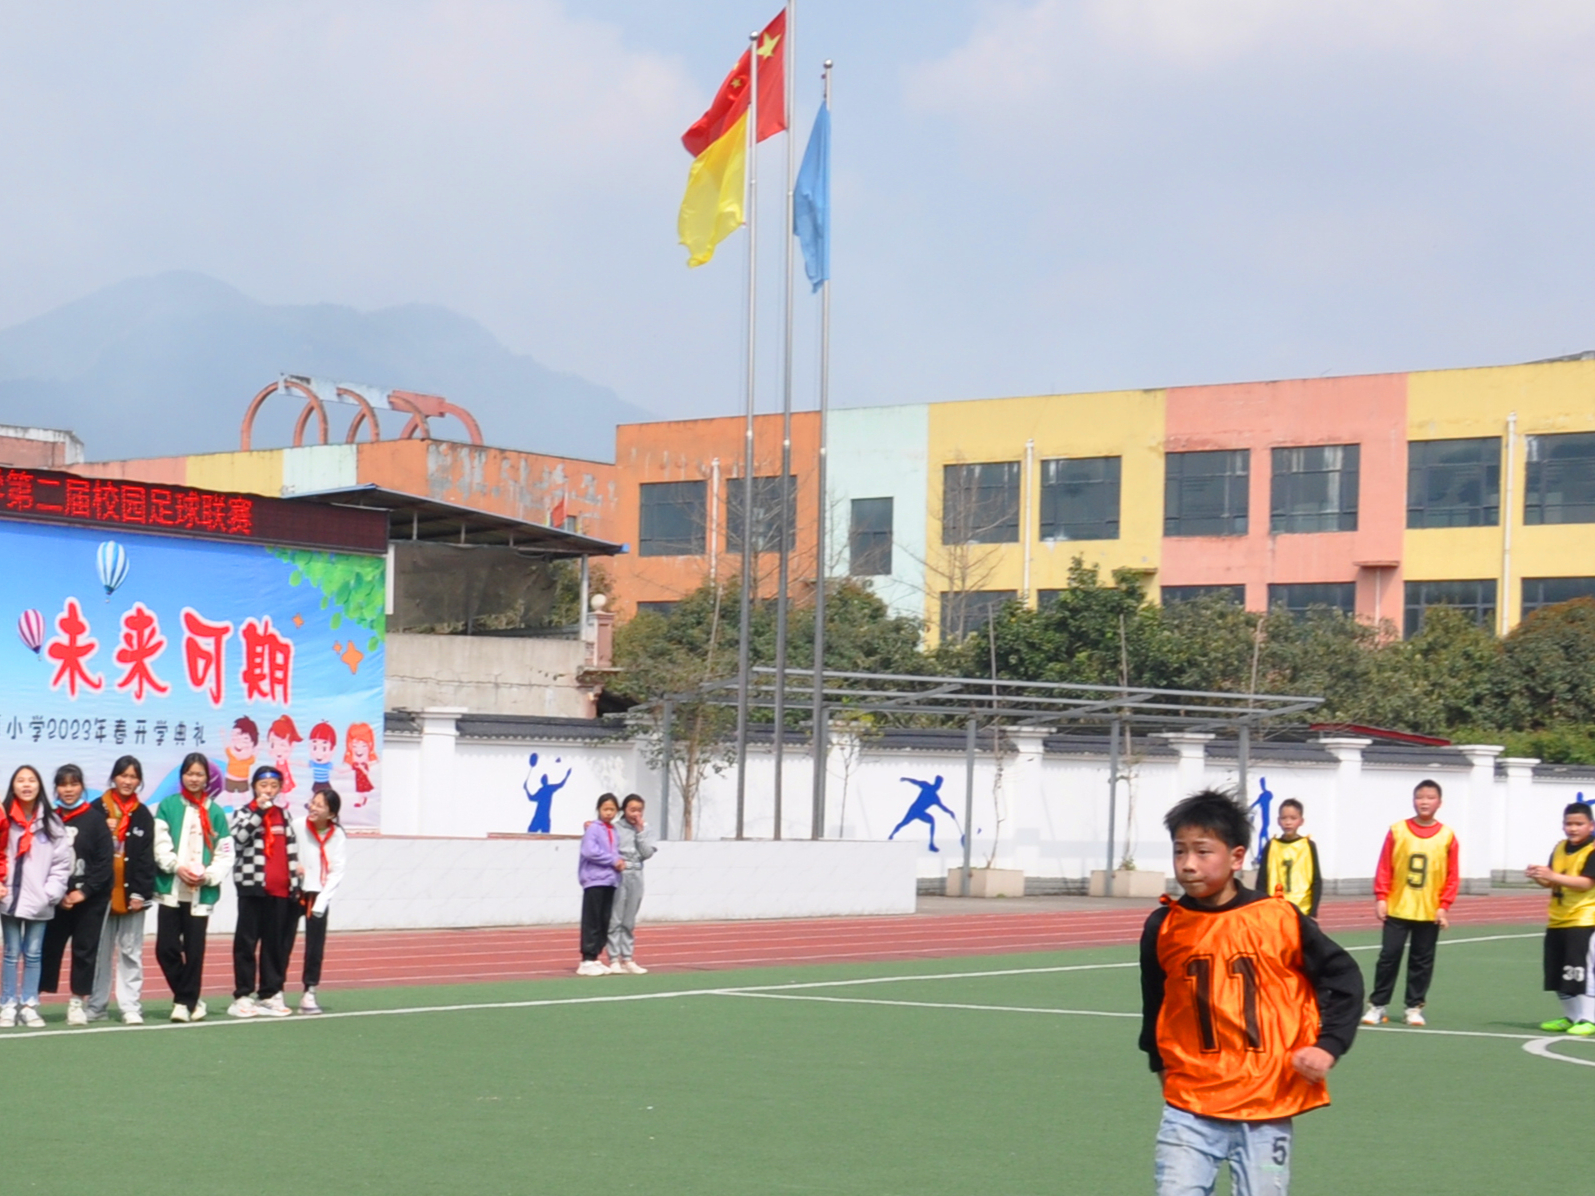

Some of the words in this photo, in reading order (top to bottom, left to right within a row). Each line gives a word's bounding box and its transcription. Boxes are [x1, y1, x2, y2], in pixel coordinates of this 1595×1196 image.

[47, 601, 292, 705] 未来可期
[1282, 859, 1292, 892] 1
[1407, 853, 1427, 888] 9
[1183, 952, 1265, 1054] 11
[1272, 1136, 1287, 1166] 5
